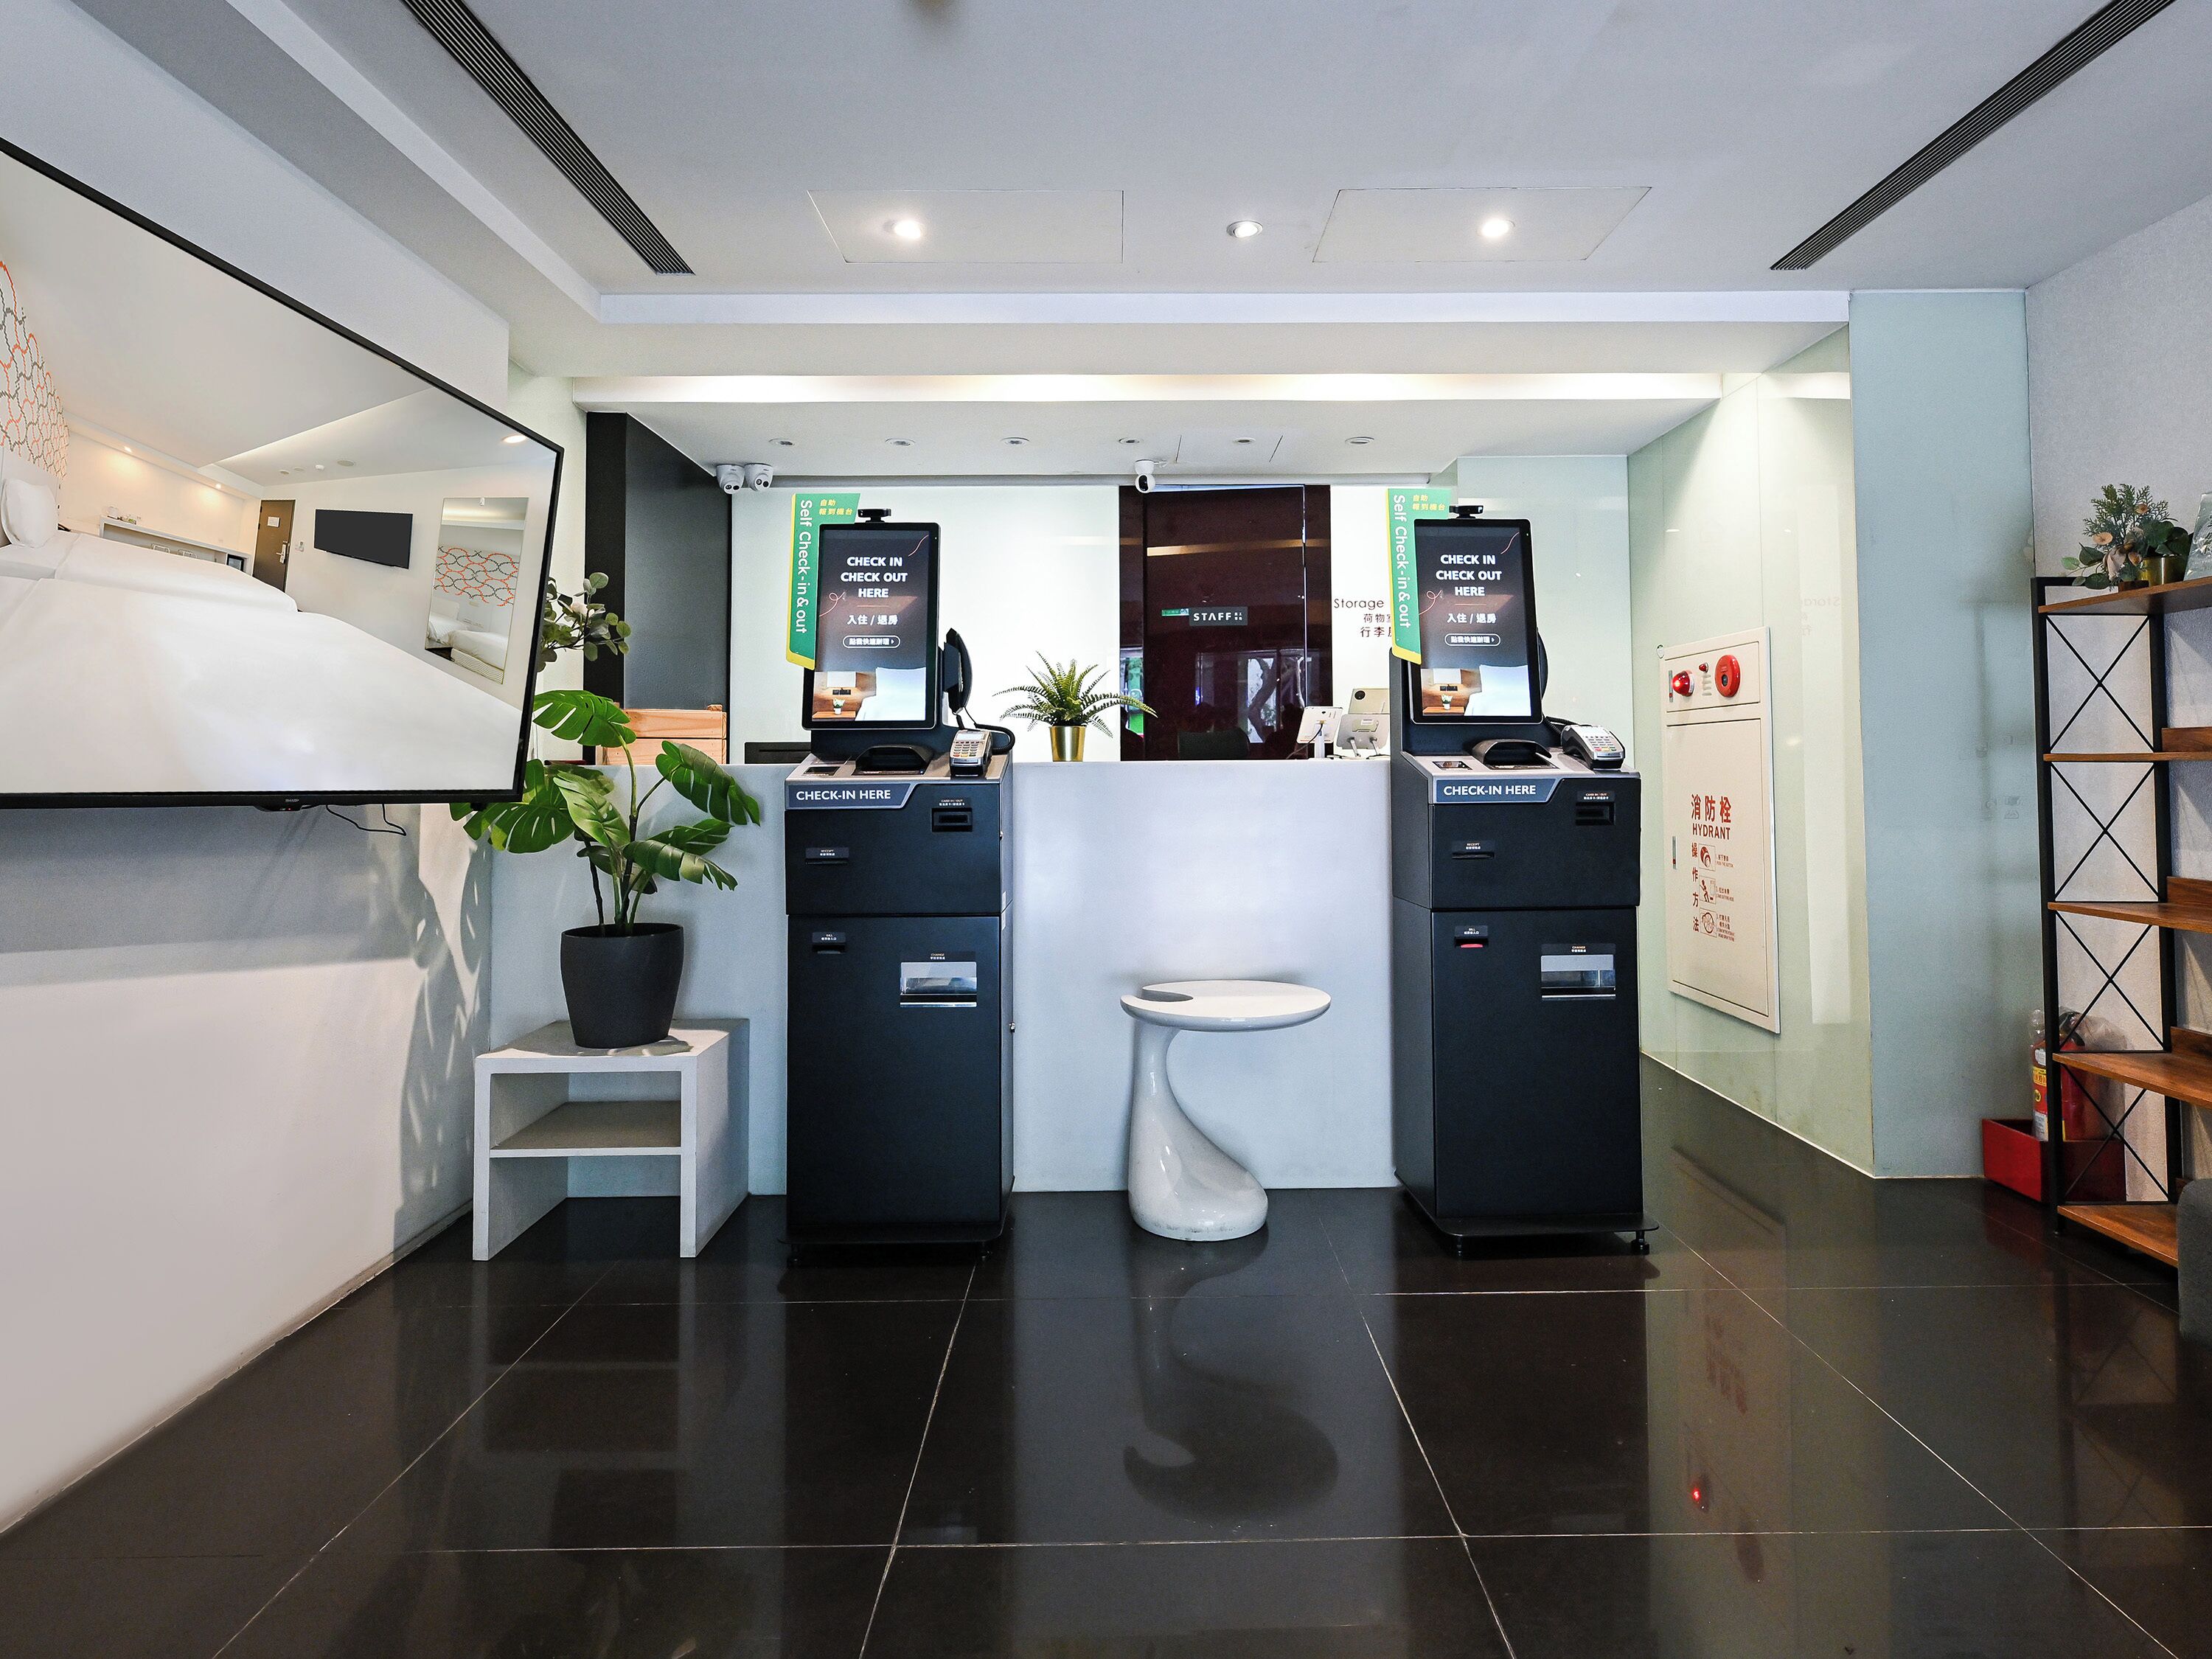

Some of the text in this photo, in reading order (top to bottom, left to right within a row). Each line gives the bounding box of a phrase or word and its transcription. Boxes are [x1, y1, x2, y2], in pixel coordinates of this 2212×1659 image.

[800, 500, 813, 527] Self
[1394, 495, 1407, 522] Self
[846, 557, 902, 566] CHECK IN
[1440, 554, 1496, 565] CHECK IN
[841, 572, 908, 582] CHECK OUT
[1436, 570, 1502, 580] CHECK OUT
[858, 588, 888, 598] HERE
[1455, 586, 1486, 597] HERE
[1334, 598, 1384, 611] Storage
[846, 614, 868, 625] 入住
[877, 614, 898, 625] 退房
[1193, 612, 1232, 622] STAFF
[1447, 613, 1467, 624] 入住
[1476, 613, 1497, 624] 退房
[796, 790, 891, 801] CHECK-IN HERE
[1443, 785, 1536, 796] CHECK-IN HERE
[1691, 793, 1731, 824] 消防栓
[1692, 823, 1731, 840] HYDRANT
